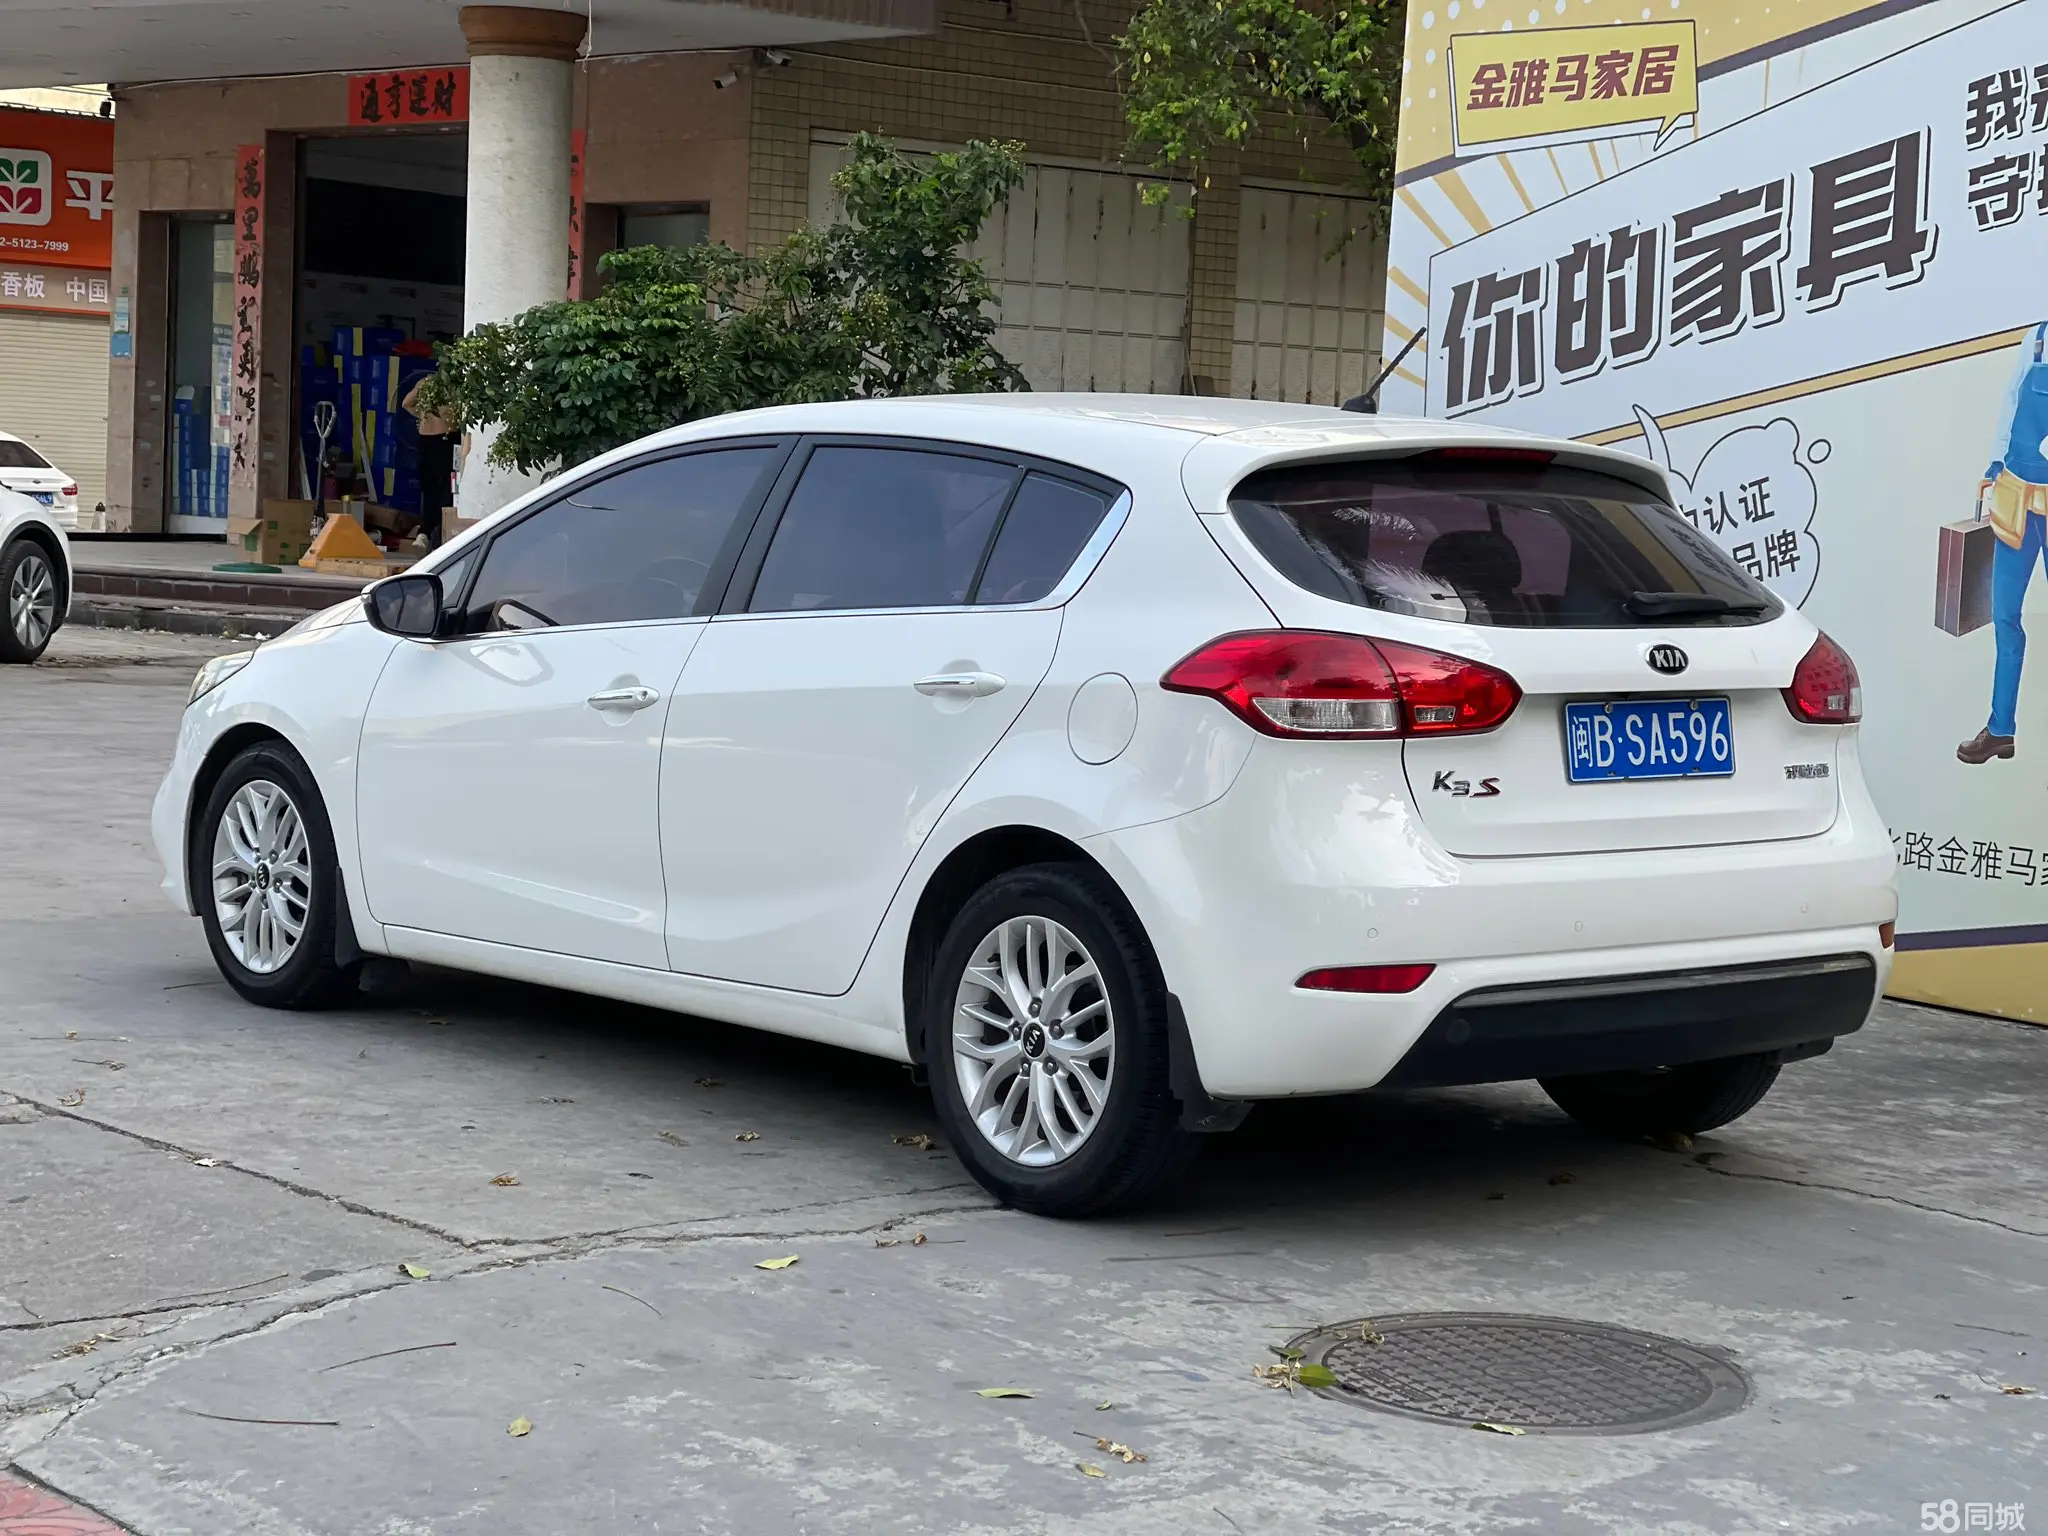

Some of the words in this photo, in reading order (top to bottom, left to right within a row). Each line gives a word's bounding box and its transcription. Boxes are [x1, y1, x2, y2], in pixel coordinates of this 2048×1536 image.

[1466, 45, 1679, 111] 金雅马家居
[65, 170, 113, 220] 平
[1967, 143, 2048, 231] 守
[1, 271, 45, 298] 香板
[66, 276, 108, 304] 中国
[1441, 129, 1935, 413] 你的家具
[1732, 528, 1801, 582] 品牌
[1653, 649, 1686, 668] KIA
[1888, 827, 2048, 886] 路金雅马
[1025, 1029, 1041, 1054] KIA
